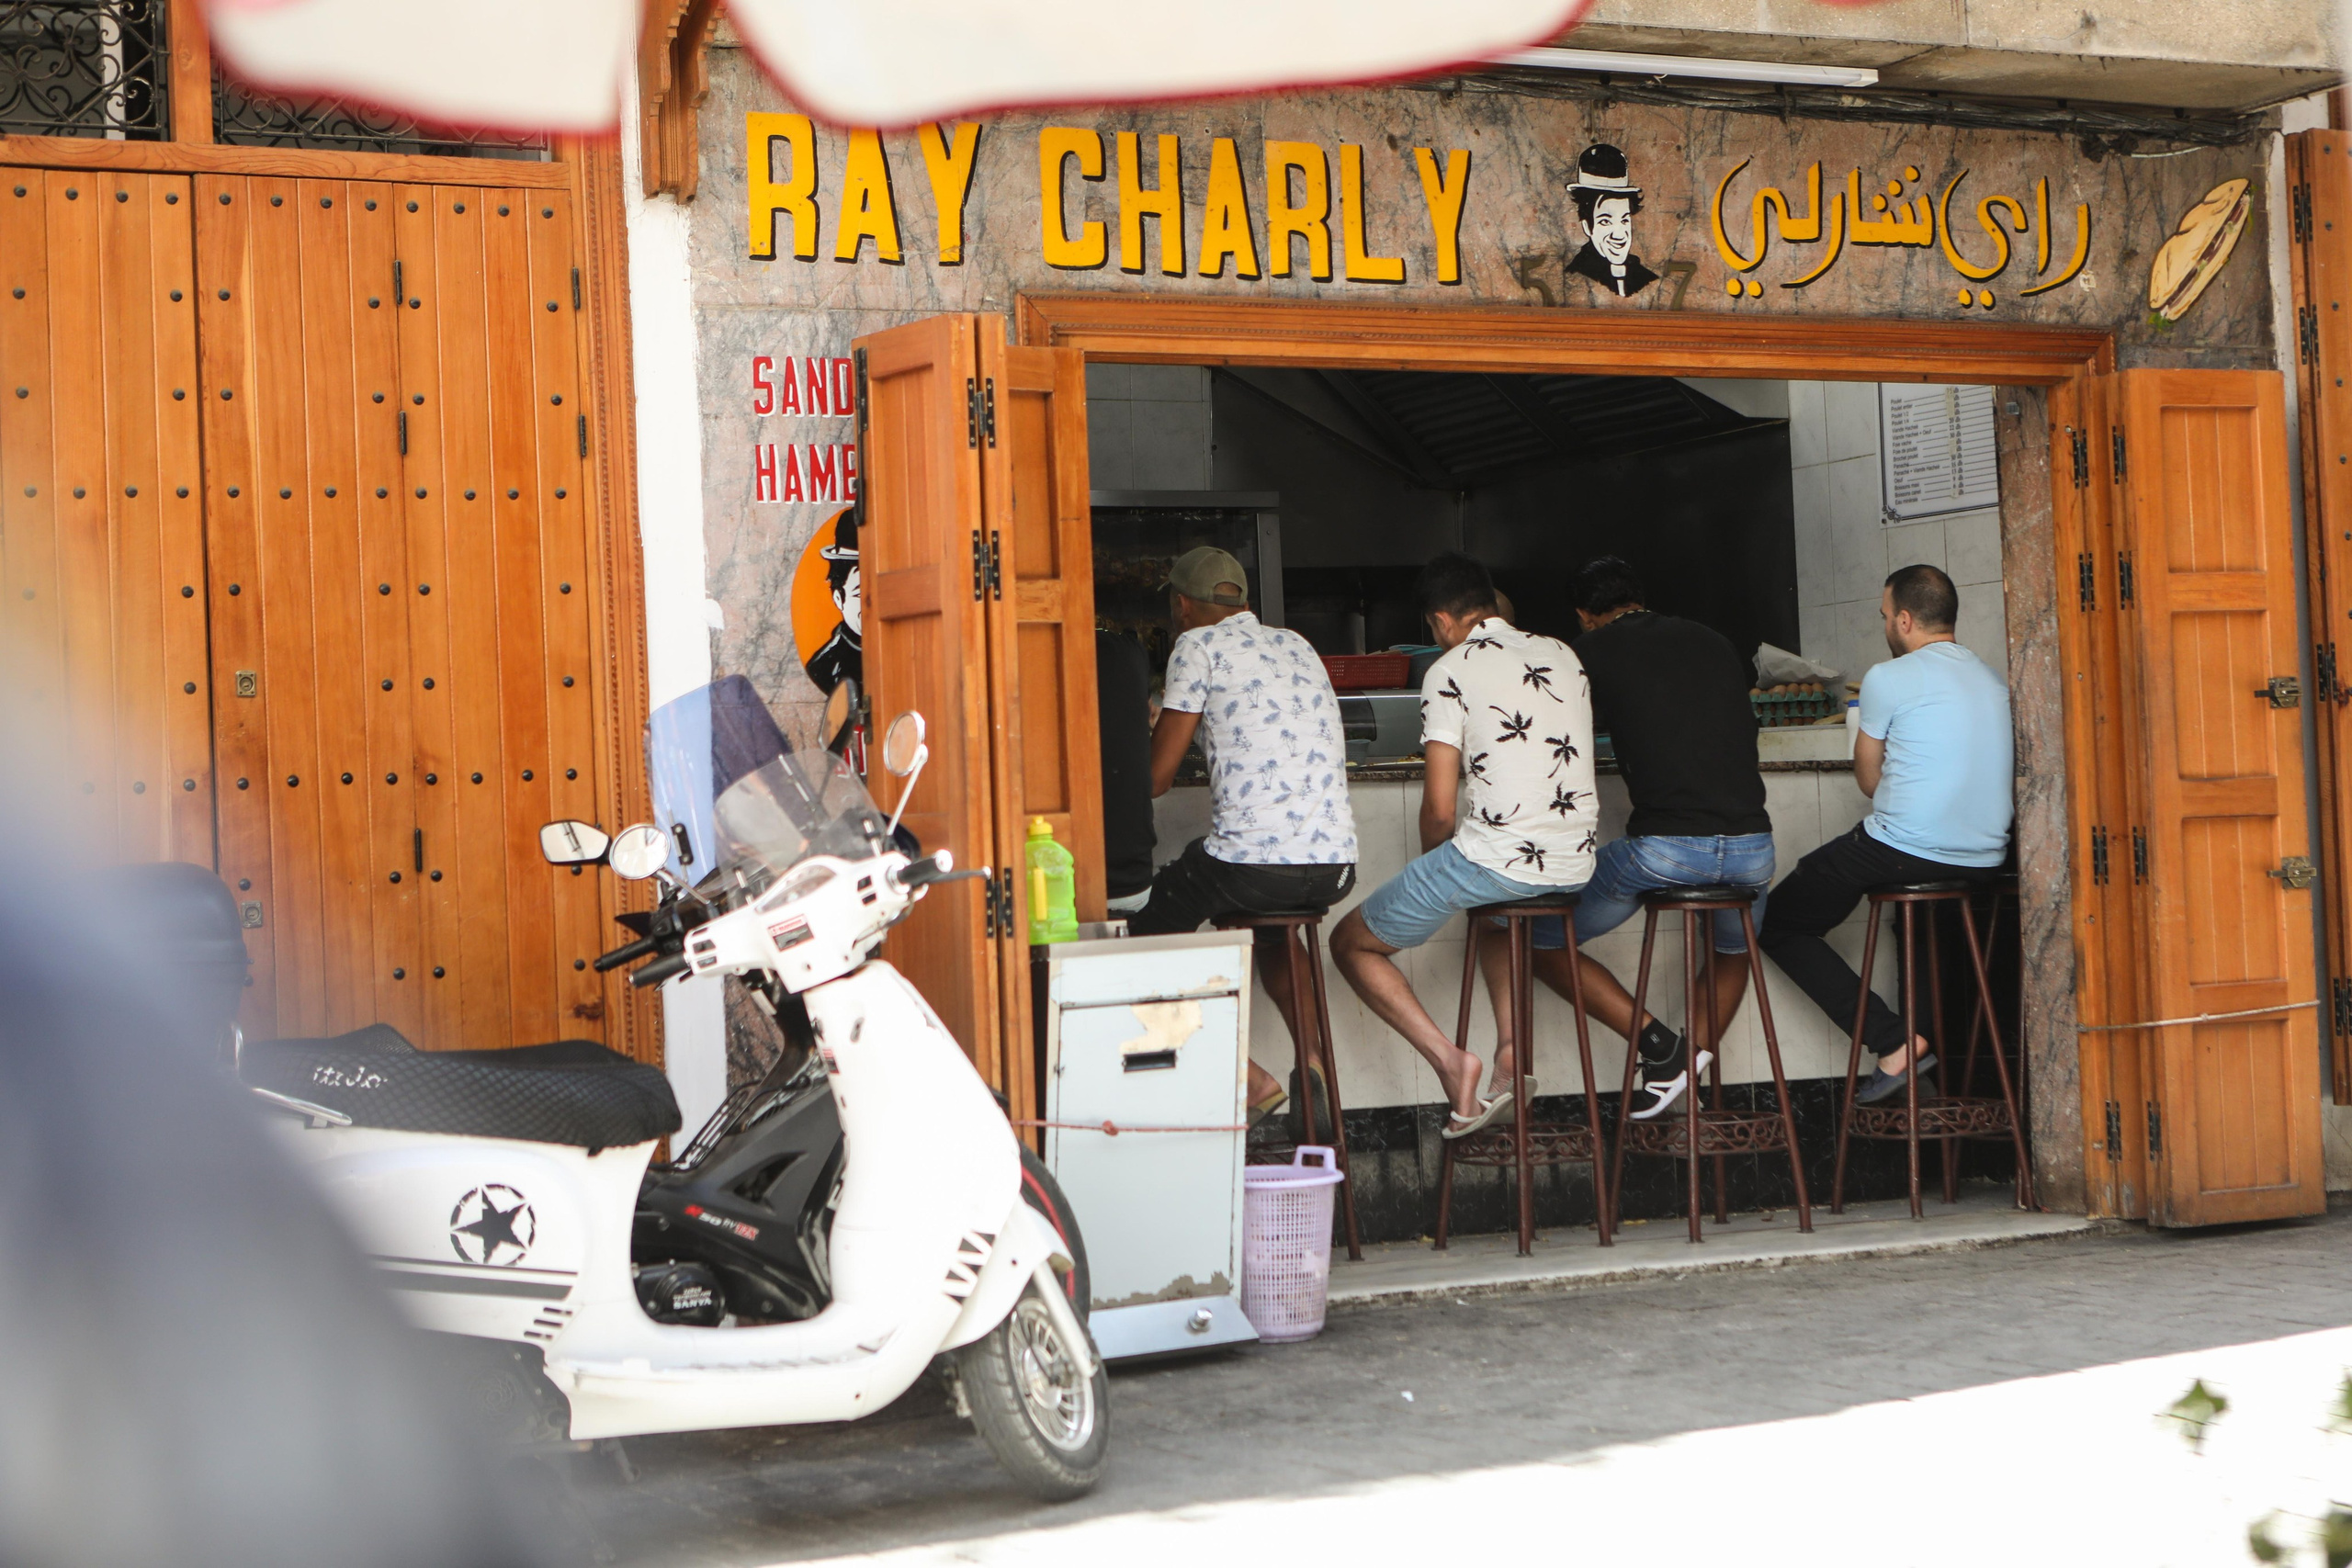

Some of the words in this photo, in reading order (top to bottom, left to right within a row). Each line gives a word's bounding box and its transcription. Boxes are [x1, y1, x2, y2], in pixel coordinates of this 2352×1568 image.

[747, 112, 981, 266] RAY
[1039, 127, 1471, 286] CHARLY
[1712, 159, 1935, 299] شارلي
[1940, 169, 2089, 309] راي
[753, 356, 854, 418] SAND
